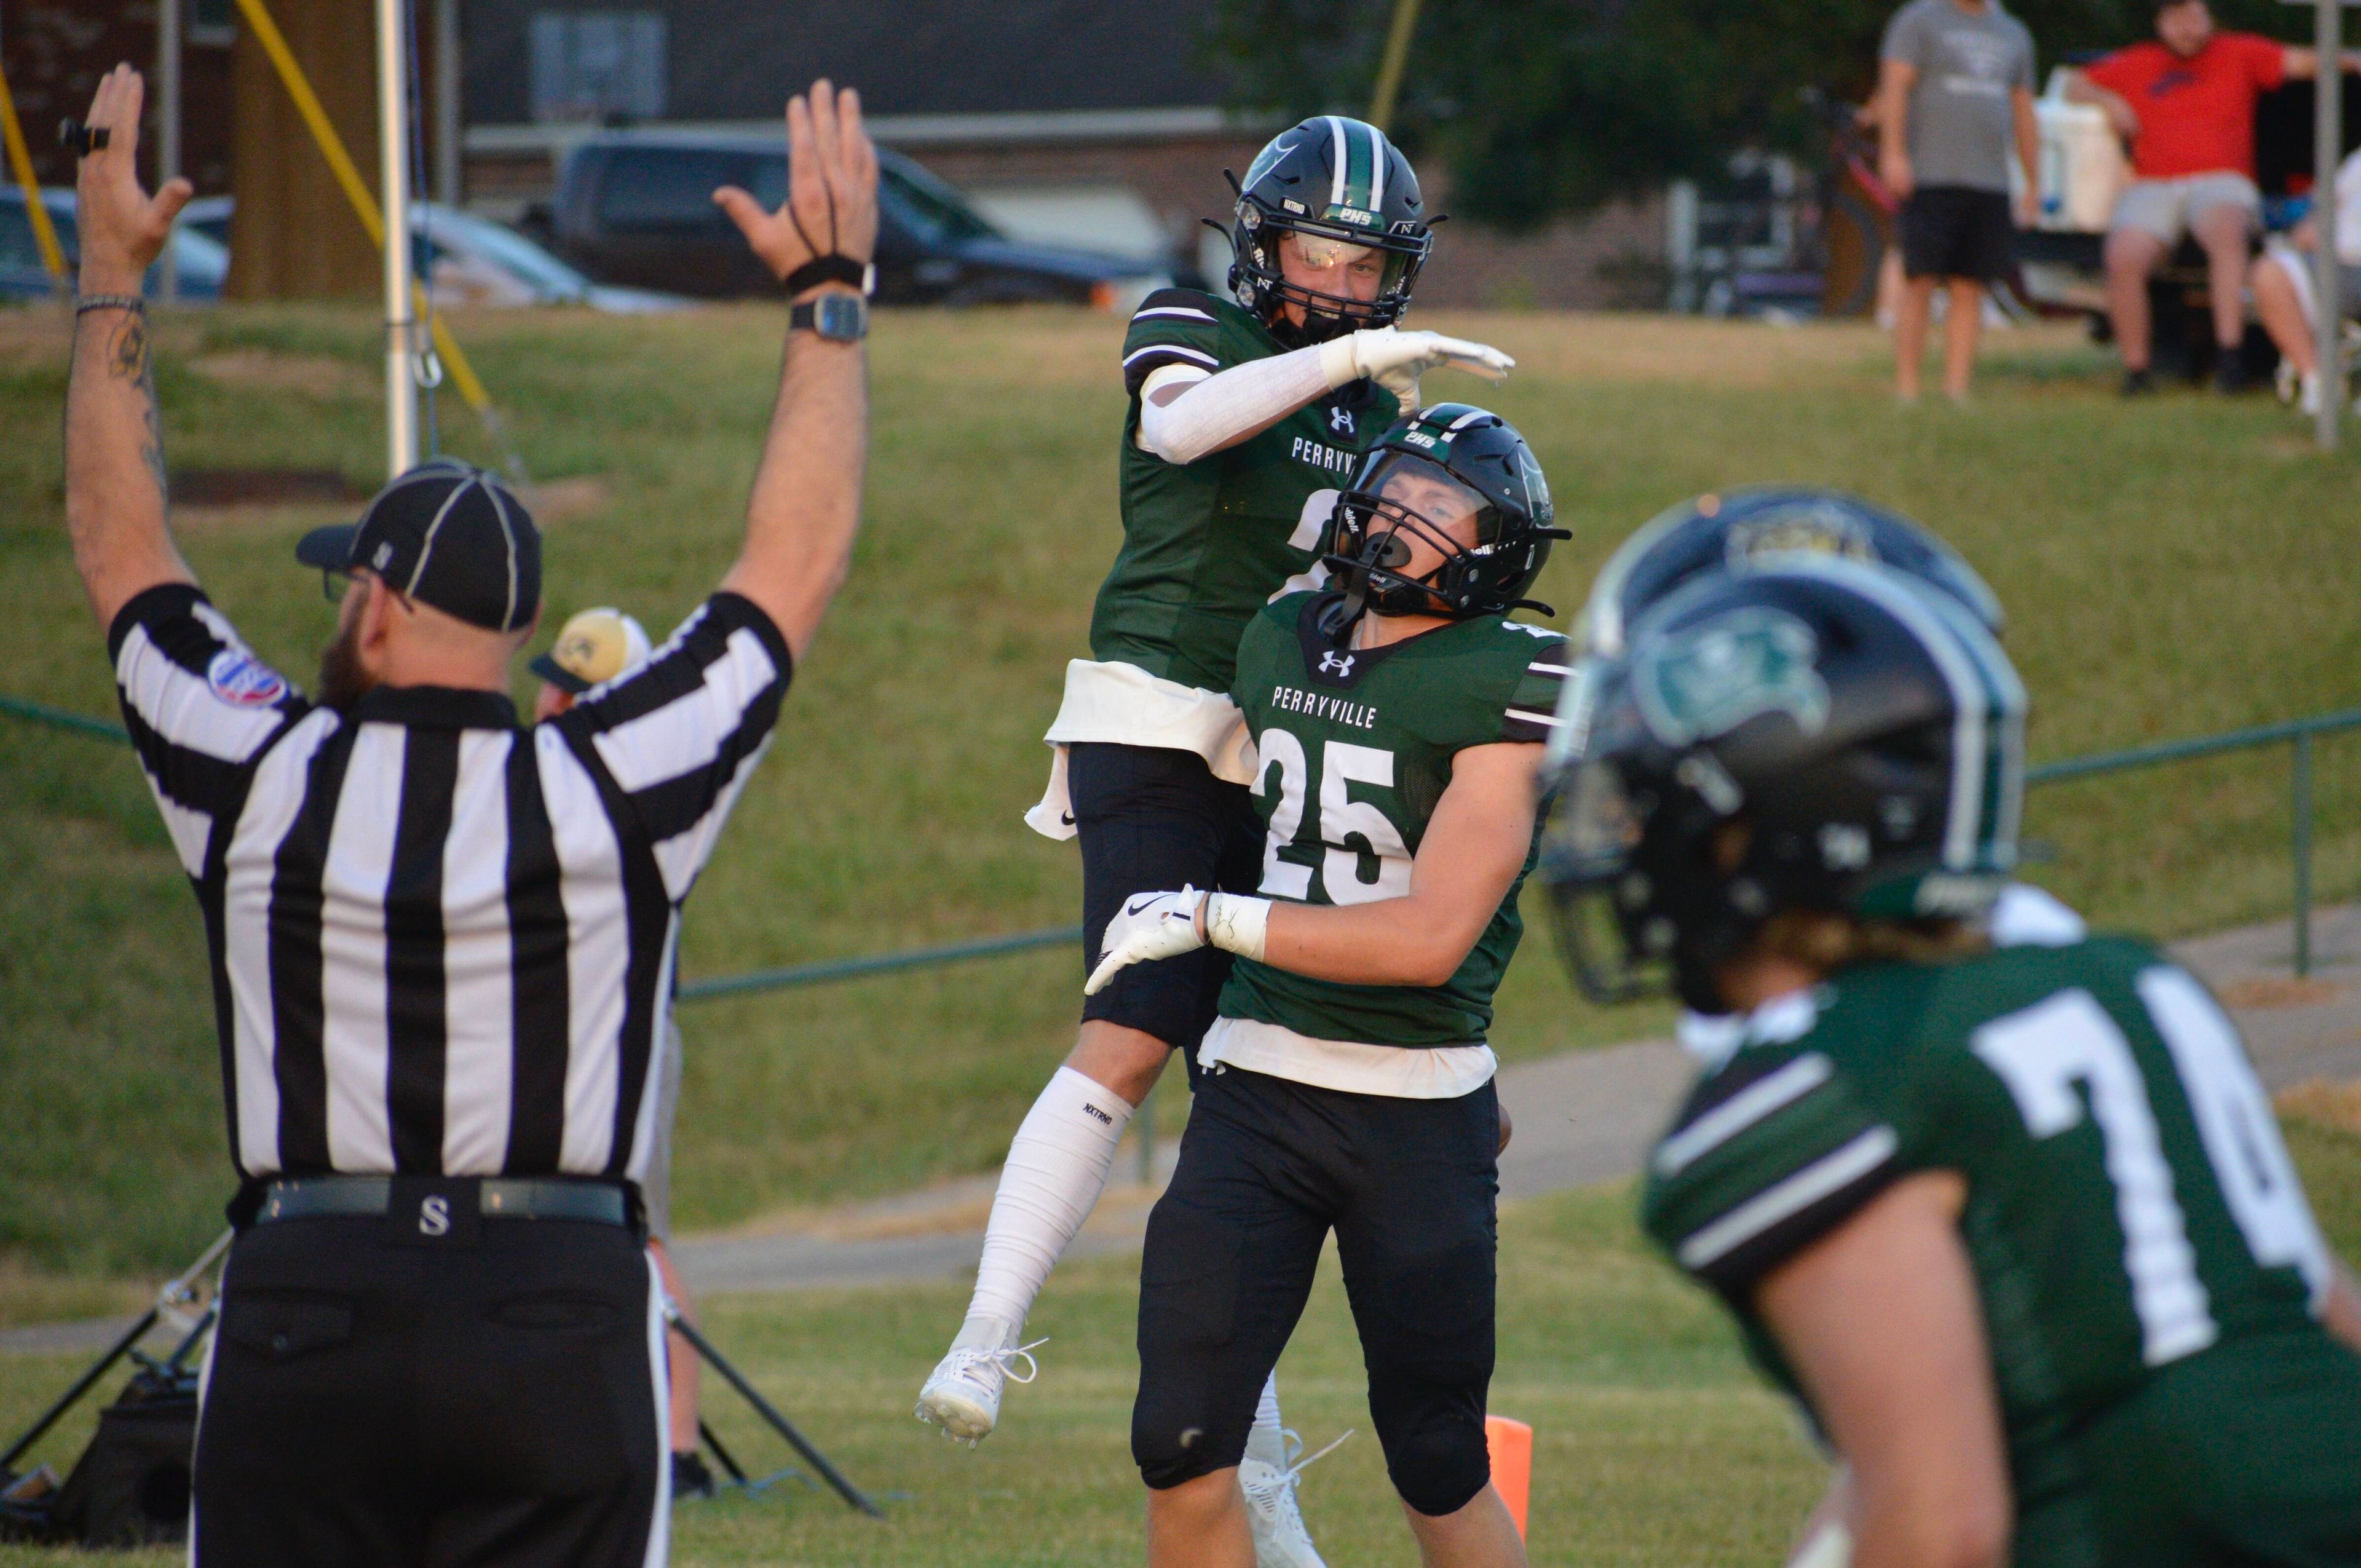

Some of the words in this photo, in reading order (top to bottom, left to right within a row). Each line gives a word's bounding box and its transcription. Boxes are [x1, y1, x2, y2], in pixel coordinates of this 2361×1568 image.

[1283, 199, 1305, 215] NXTRND
[1339, 207, 1373, 226] PHS
[1292, 437, 1357, 474] PERRYV
[1272, 686, 1377, 729] PERRYVILLE
[1249, 728, 1415, 906] 25
[1083, 1103, 1113, 1125] NXTRND
[1969, 966, 2333, 1368] 74
[419, 1195, 450, 1237] S
